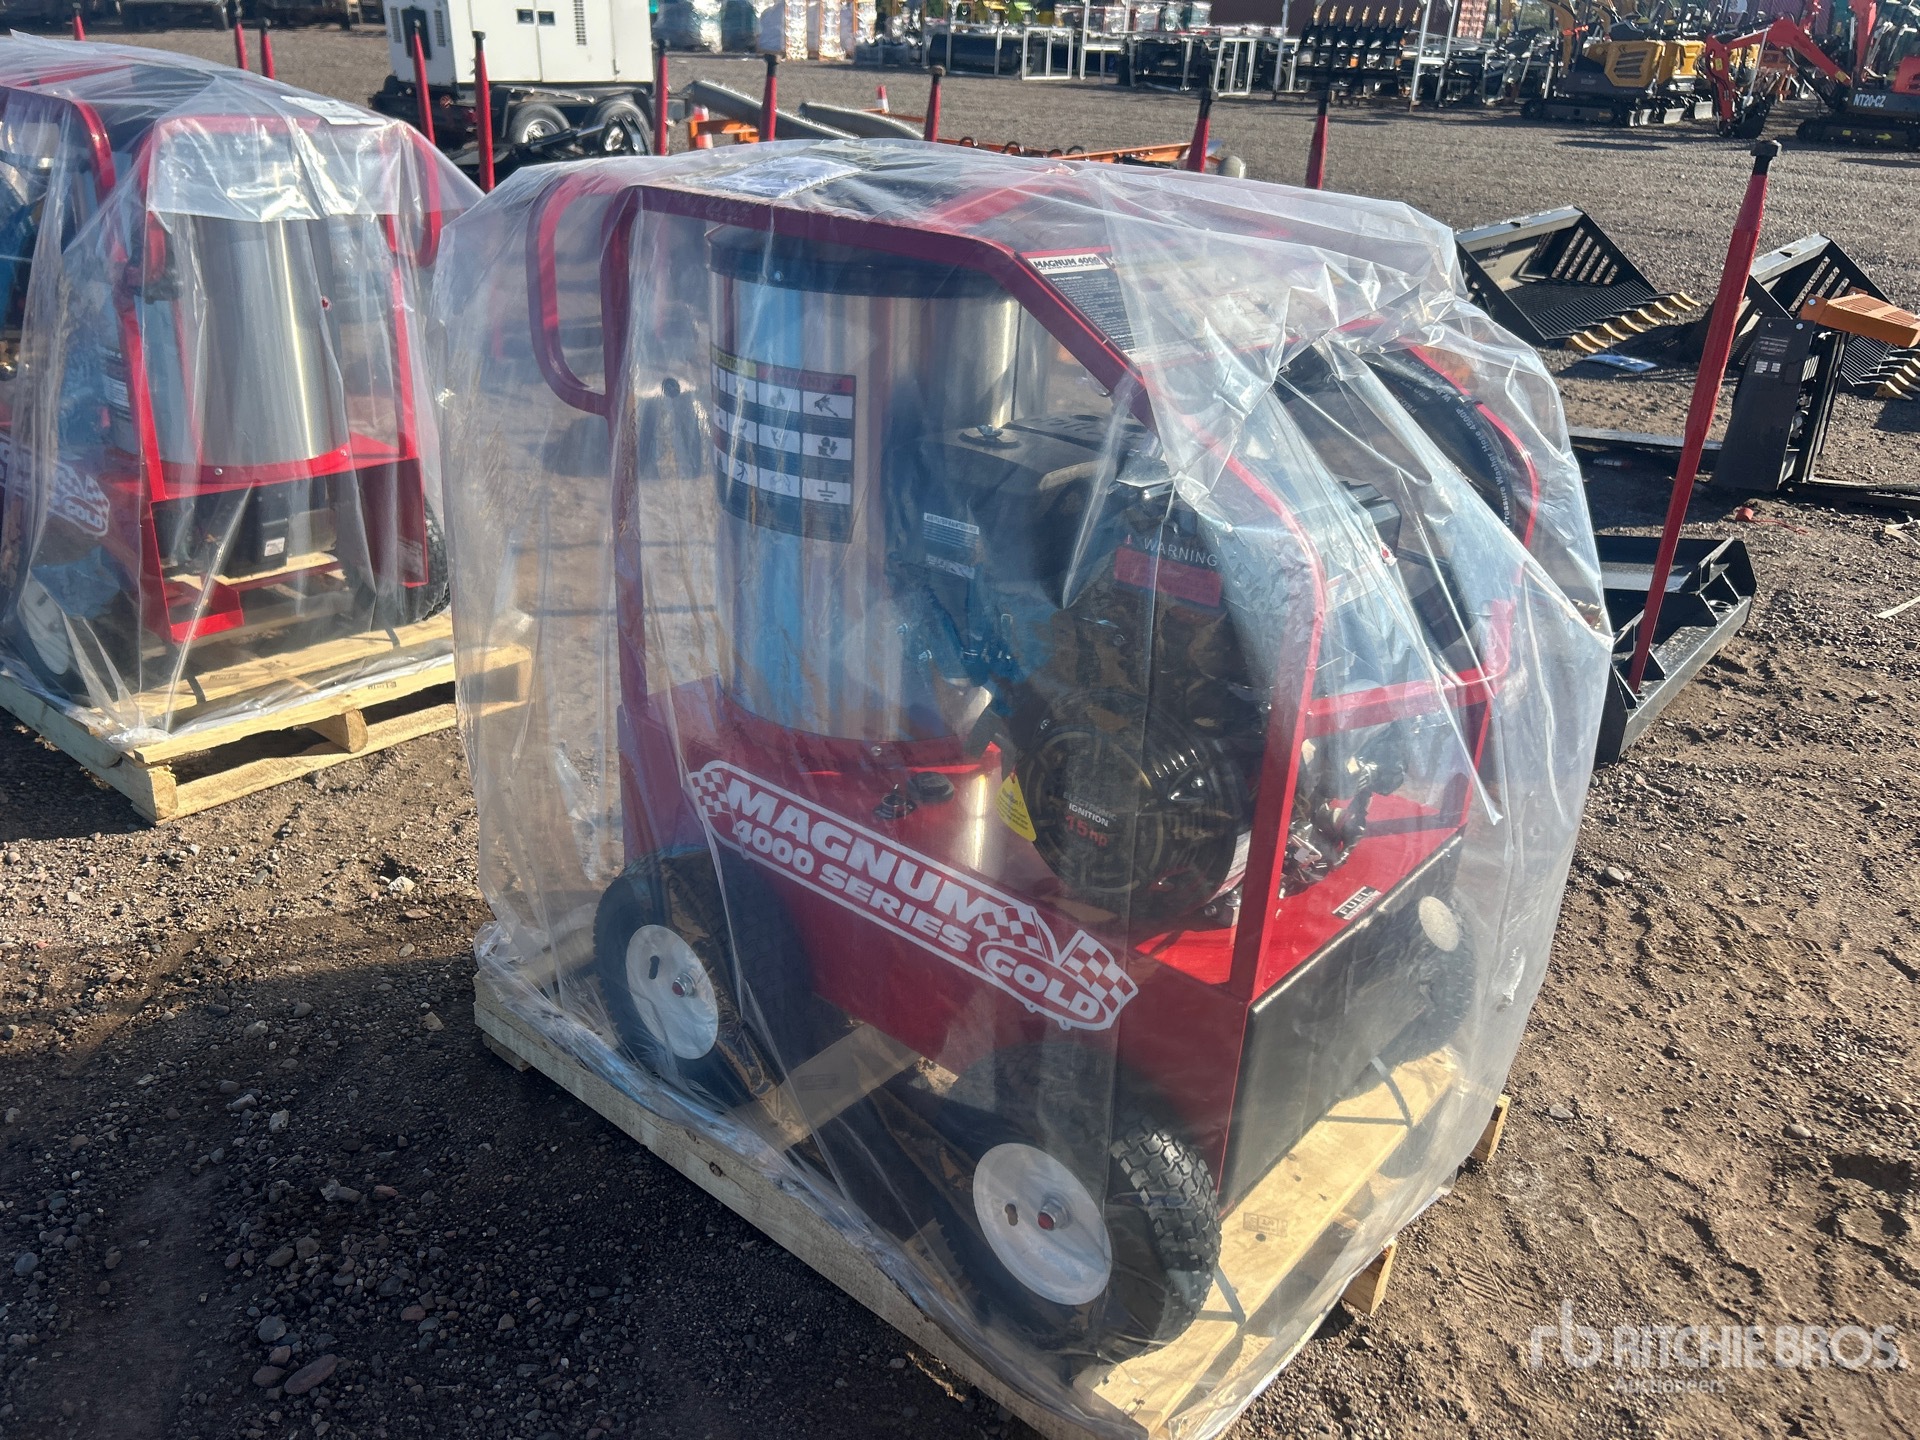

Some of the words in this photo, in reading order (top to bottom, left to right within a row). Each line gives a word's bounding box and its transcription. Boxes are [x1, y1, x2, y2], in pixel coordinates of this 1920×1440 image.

[1853, 93, 1887, 108] NT20-CZ
[1033, 258, 1077, 269] MAGNUM
[1500, 486, 1511, 526] Pressure
[1144, 537, 1218, 567] WARNING
[1069, 803, 1109, 827] IGNITION
[727, 778, 1003, 928] MAGNUM
[731, 819, 815, 875] 4000
[819, 863, 972, 952] SERIES
[1339, 889, 1373, 915] FUEL
[984, 948, 1100, 1020] GOLD
